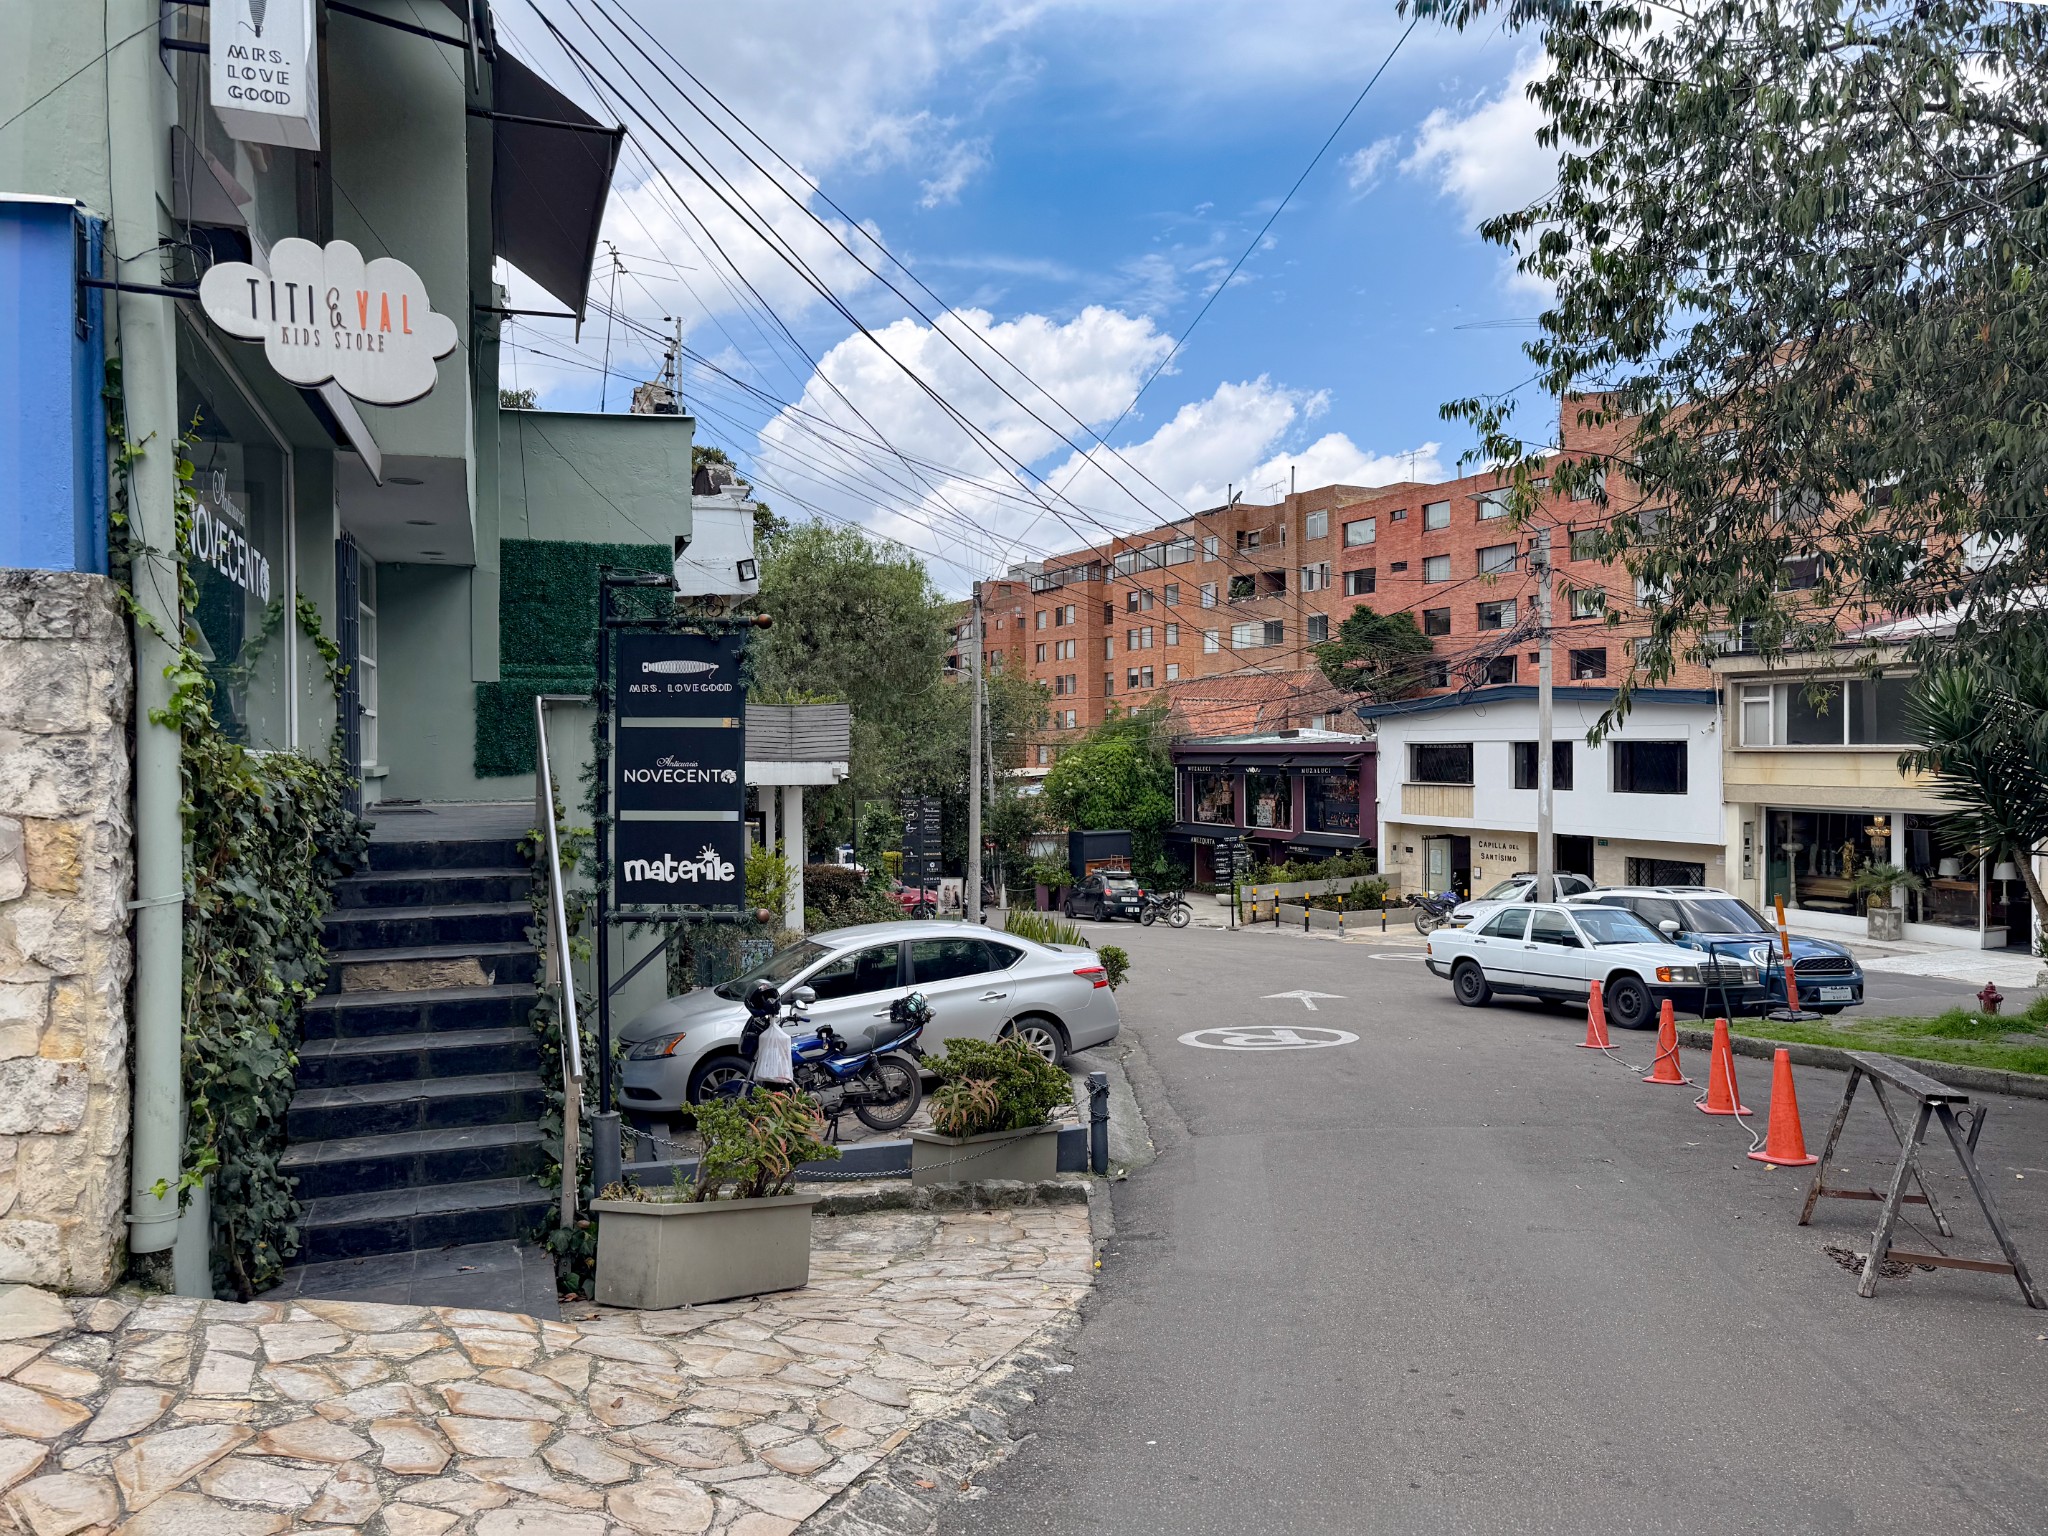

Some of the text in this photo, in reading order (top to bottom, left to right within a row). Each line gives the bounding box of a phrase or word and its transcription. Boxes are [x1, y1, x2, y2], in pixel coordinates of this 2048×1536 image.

[227, 44, 291, 66] MRS.
[227, 64, 290, 86] LOVE
[227, 85, 291, 106] GOOD
[246, 278, 413, 334] TITI & VAL
[281, 326, 385, 353] KIDS STORE
[628, 682, 734, 694] MRS. LOVEGOOD
[656, 754, 699, 768] Anticuario
[1478, 840, 1507, 850] CAPILLA
[1480, 852, 1517, 863] SANTÍSIMO
